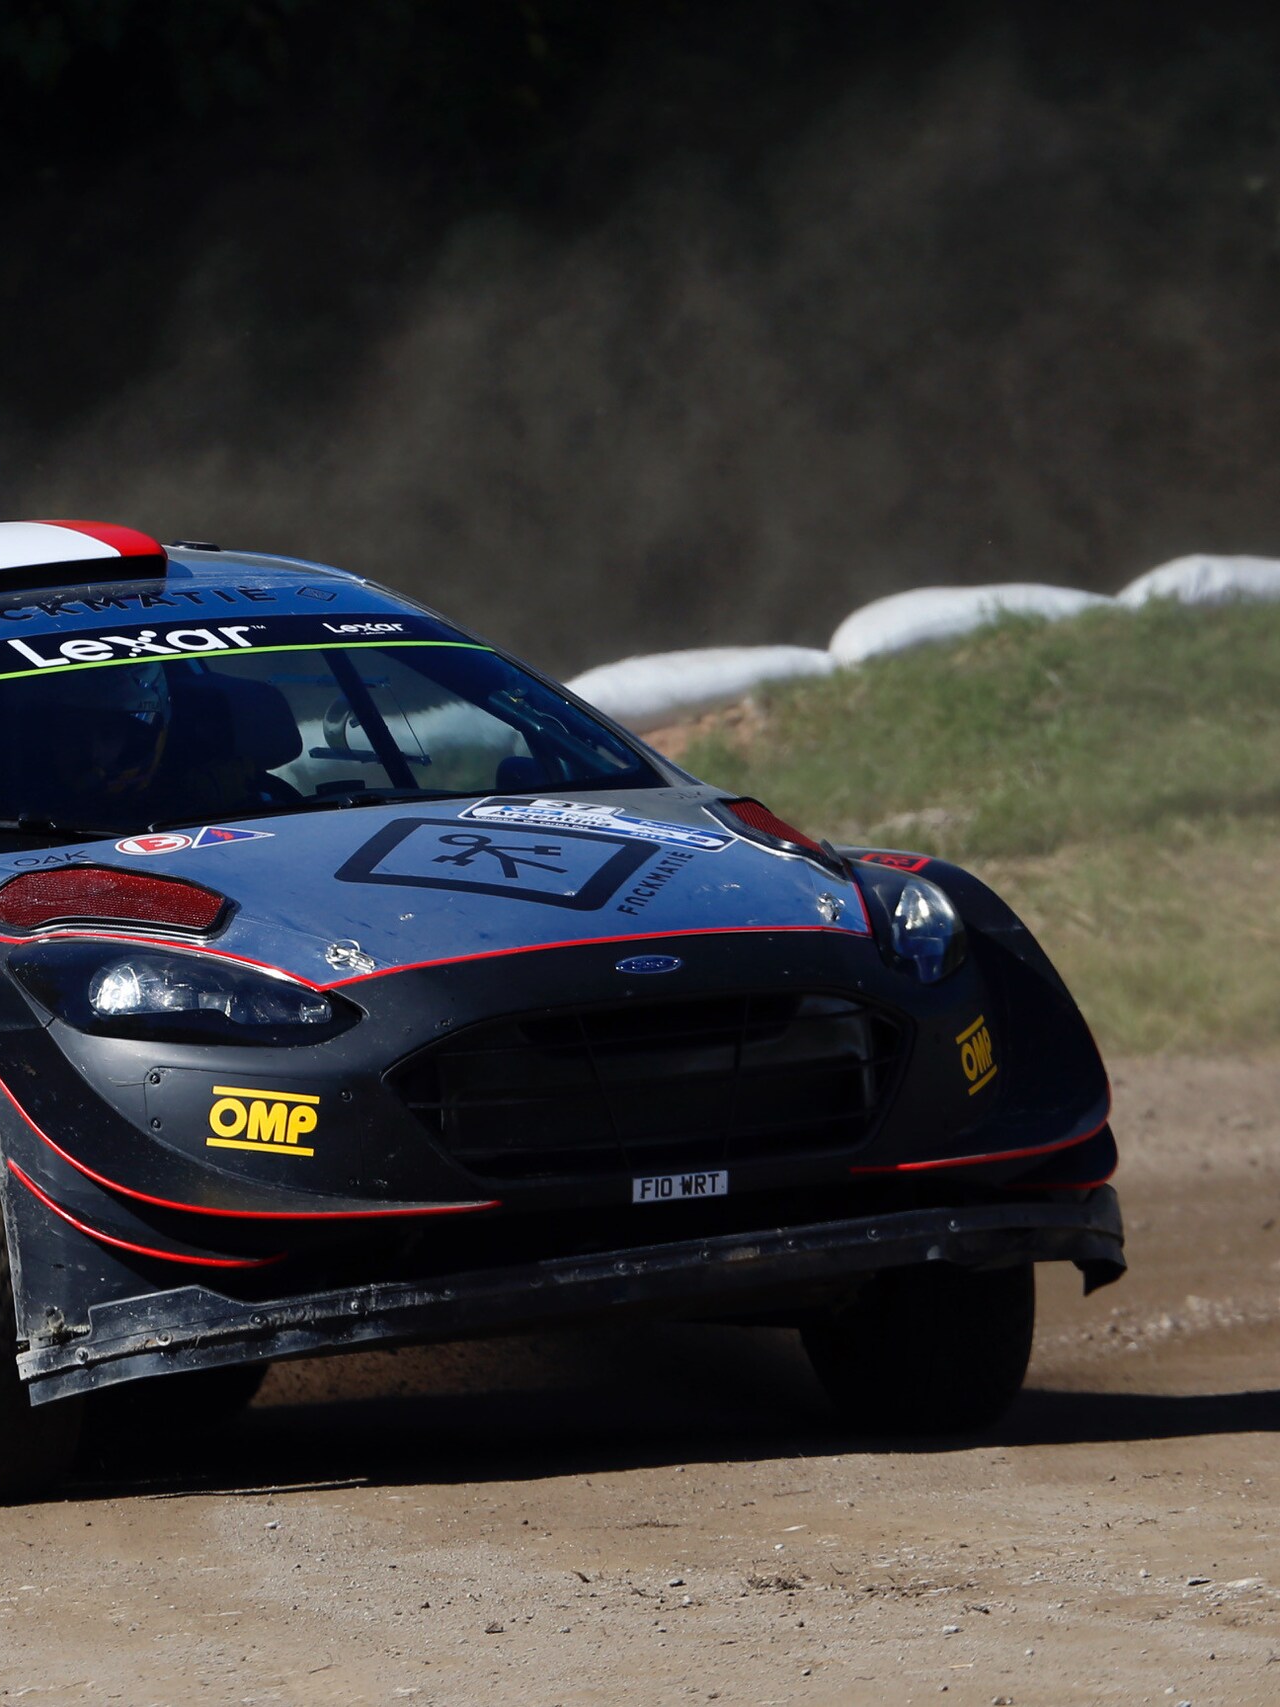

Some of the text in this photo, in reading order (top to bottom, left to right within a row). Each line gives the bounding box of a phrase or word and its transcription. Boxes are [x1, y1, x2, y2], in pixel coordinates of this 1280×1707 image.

[322, 622, 404, 634] Lexar
[7, 629, 252, 668] Lexar
[14, 850, 91, 867] OAK
[960, 1025, 993, 1081] OMP
[209, 1097, 318, 1144] OMP
[640, 1173, 720, 1200] F10 WRT
